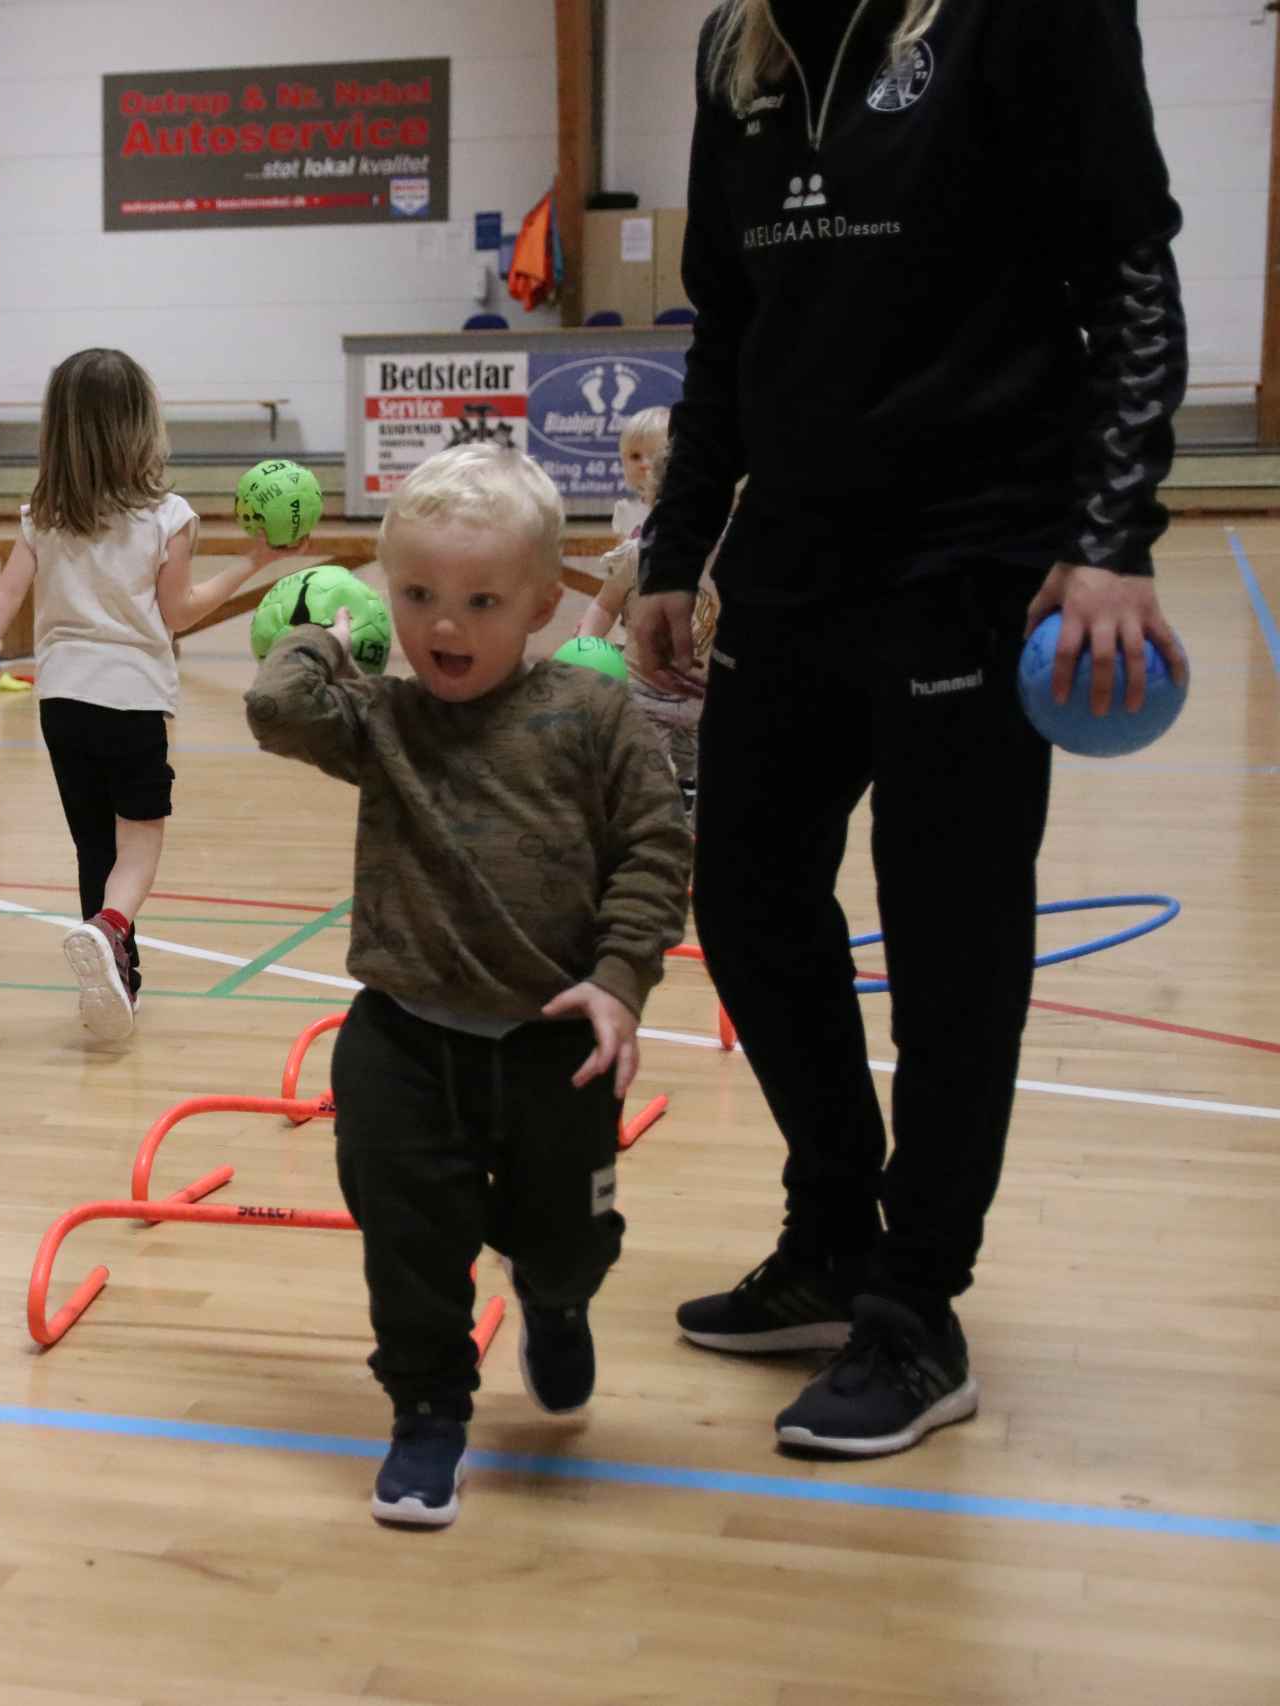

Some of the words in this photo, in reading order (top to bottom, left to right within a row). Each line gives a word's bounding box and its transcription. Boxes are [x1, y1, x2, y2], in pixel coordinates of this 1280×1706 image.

[120, 90, 230, 118] Outrup
[241, 84, 267, 112] &
[335, 76, 432, 106] Nebel
[120, 113, 429, 157] Autoservice
[303, 156, 357, 178] lokal
[358, 154, 430, 176] kvalitet
[380, 360, 514, 391] Bedstefar
[378, 398, 444, 417] Service
[585, 460, 607, 477] 40
[911, 669, 983, 696] hummel
[237, 1206, 295, 1219] SELECT
